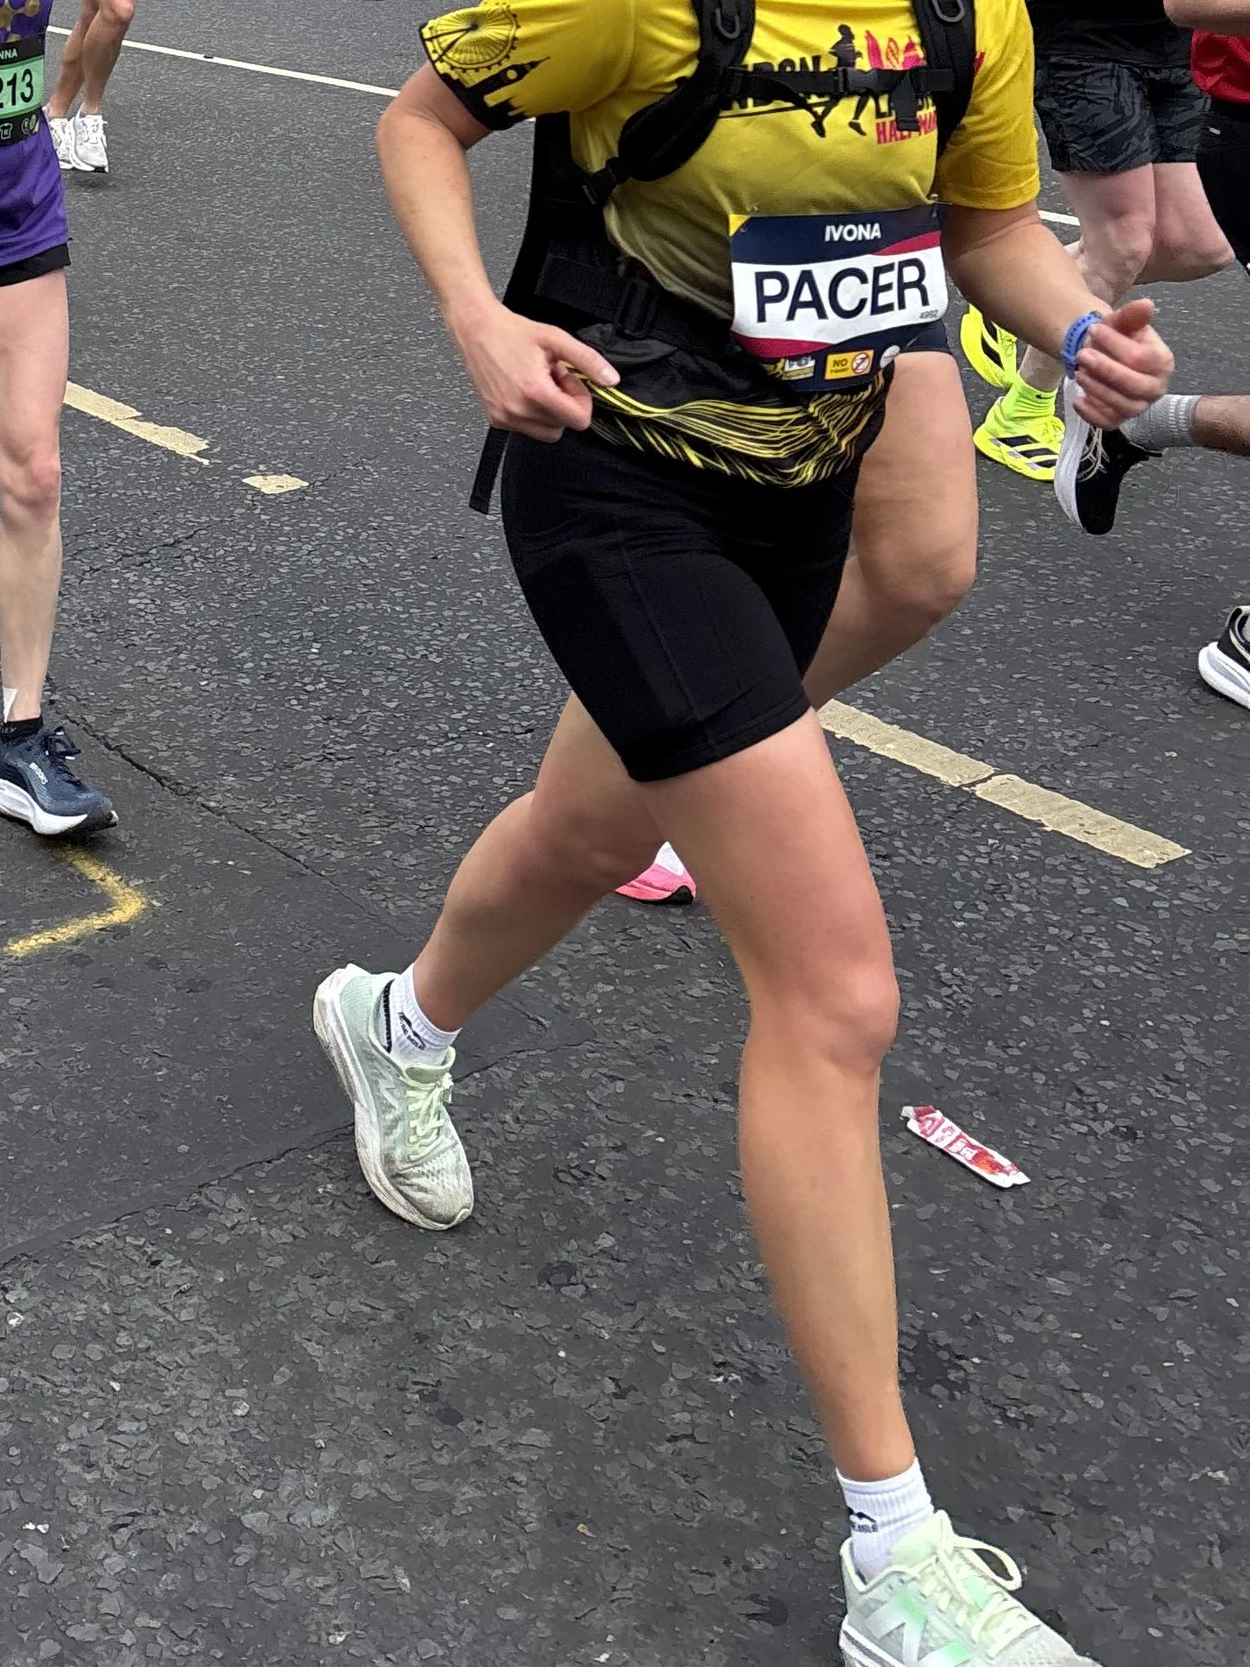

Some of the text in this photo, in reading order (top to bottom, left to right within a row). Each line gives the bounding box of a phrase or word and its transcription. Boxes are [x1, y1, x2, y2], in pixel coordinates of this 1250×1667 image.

[824, 222, 882, 242] IVONA
[754, 257, 930, 324] PACER
[833, 358, 848, 368] NO
